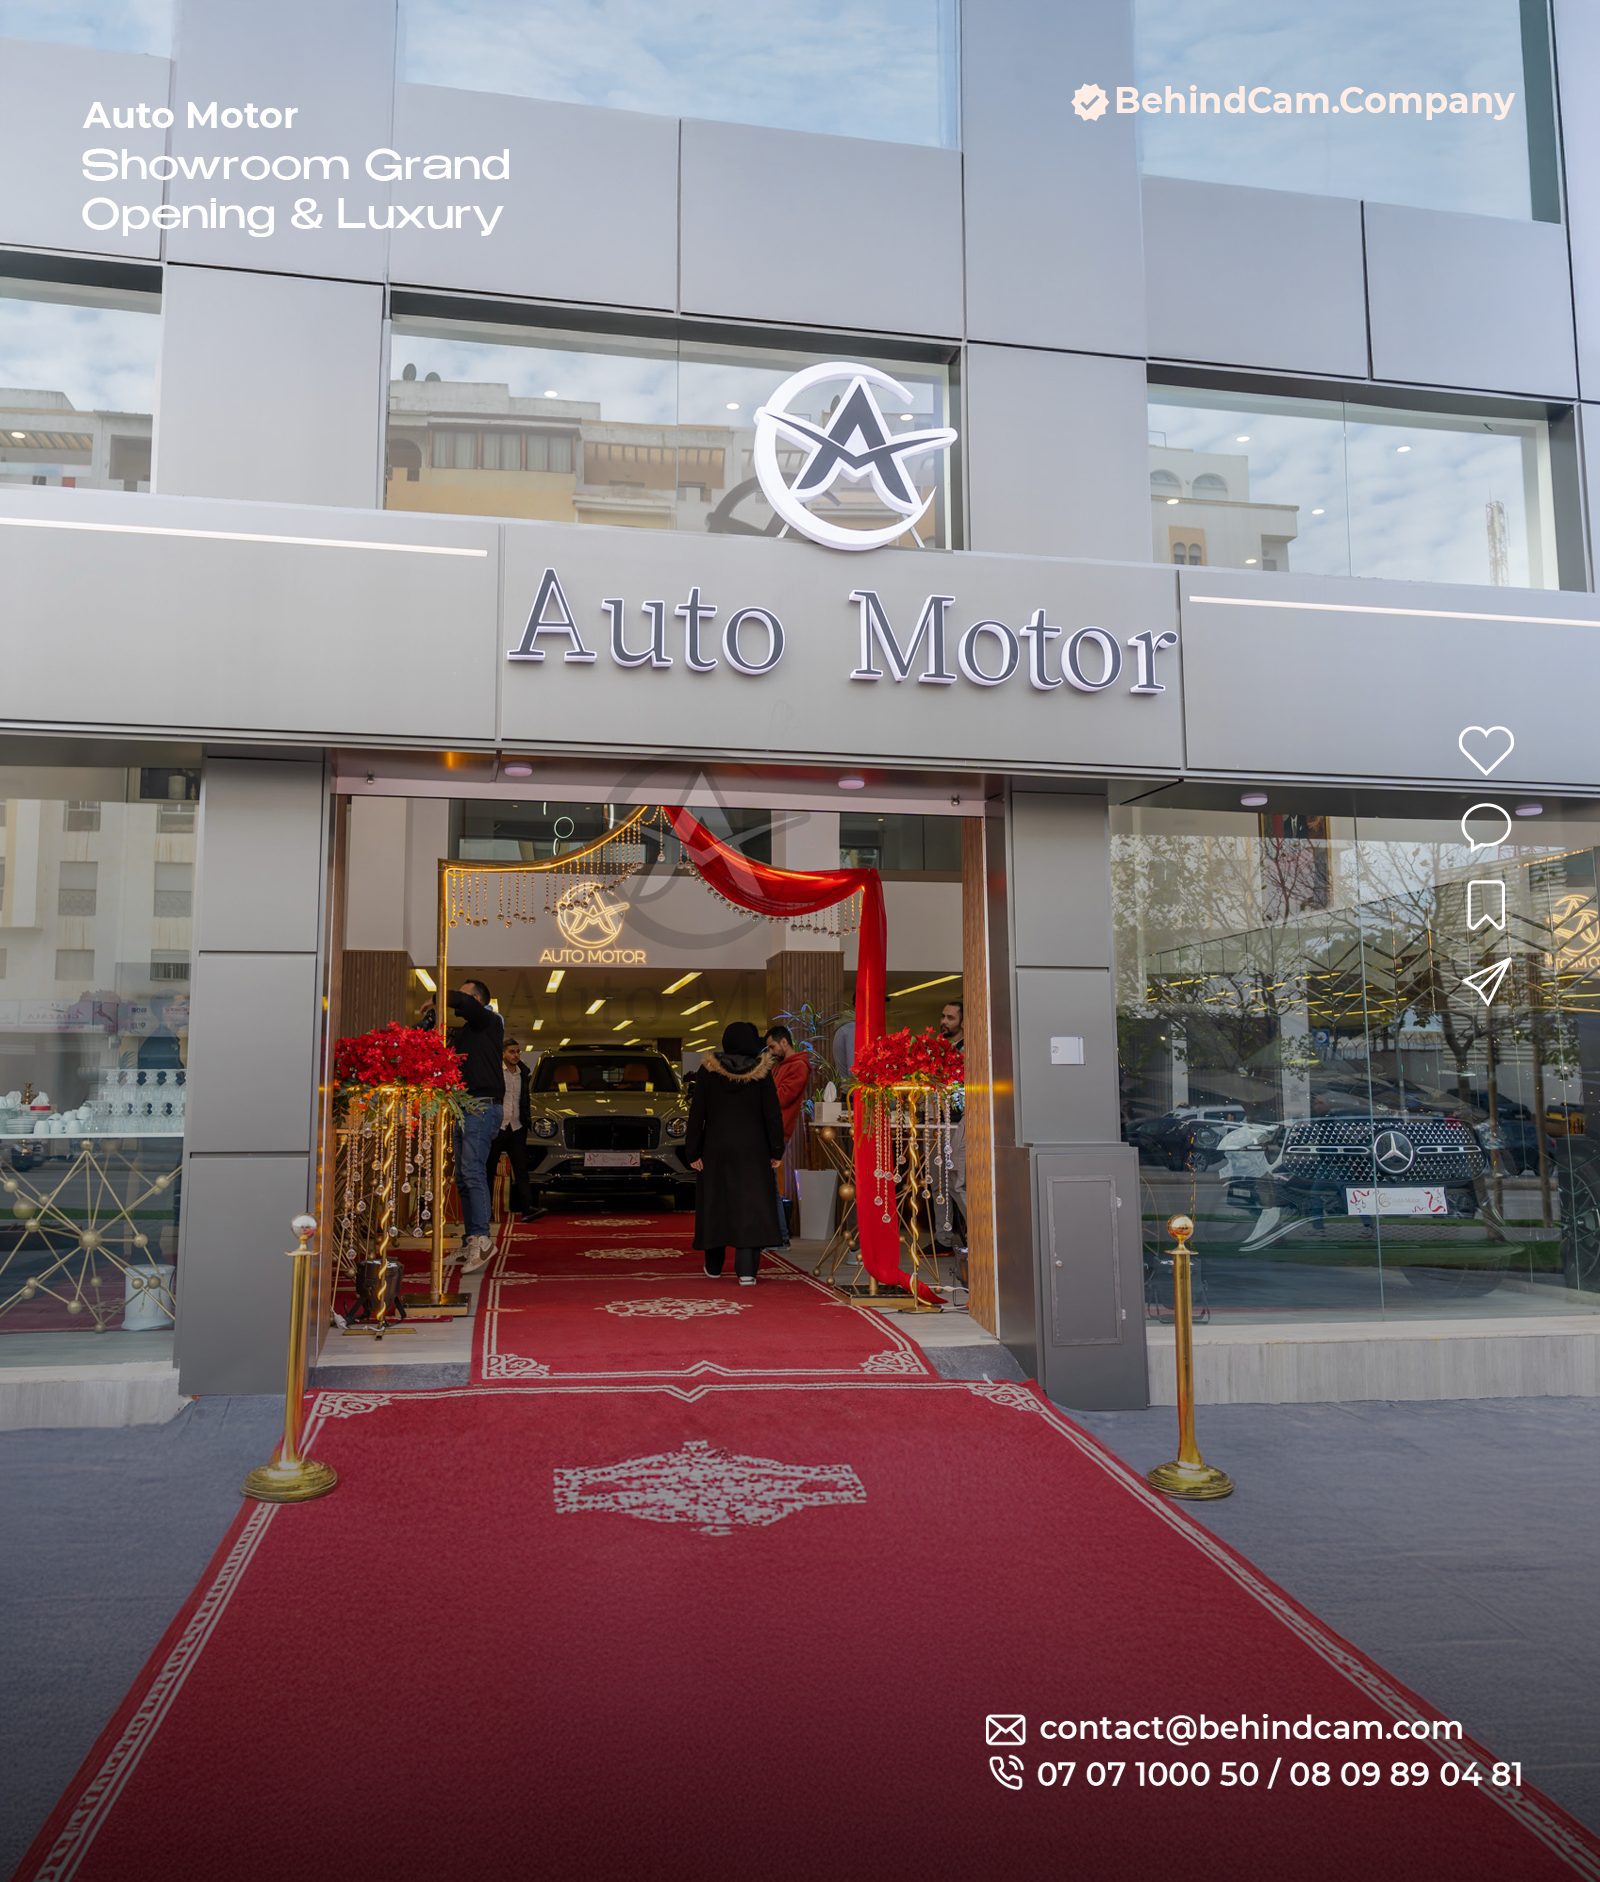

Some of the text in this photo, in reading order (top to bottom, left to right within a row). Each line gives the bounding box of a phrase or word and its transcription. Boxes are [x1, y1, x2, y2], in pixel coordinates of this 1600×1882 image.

[506, 567, 1178, 695] Auto Motor
[539, 949, 647, 964] AUTO MOTOR
